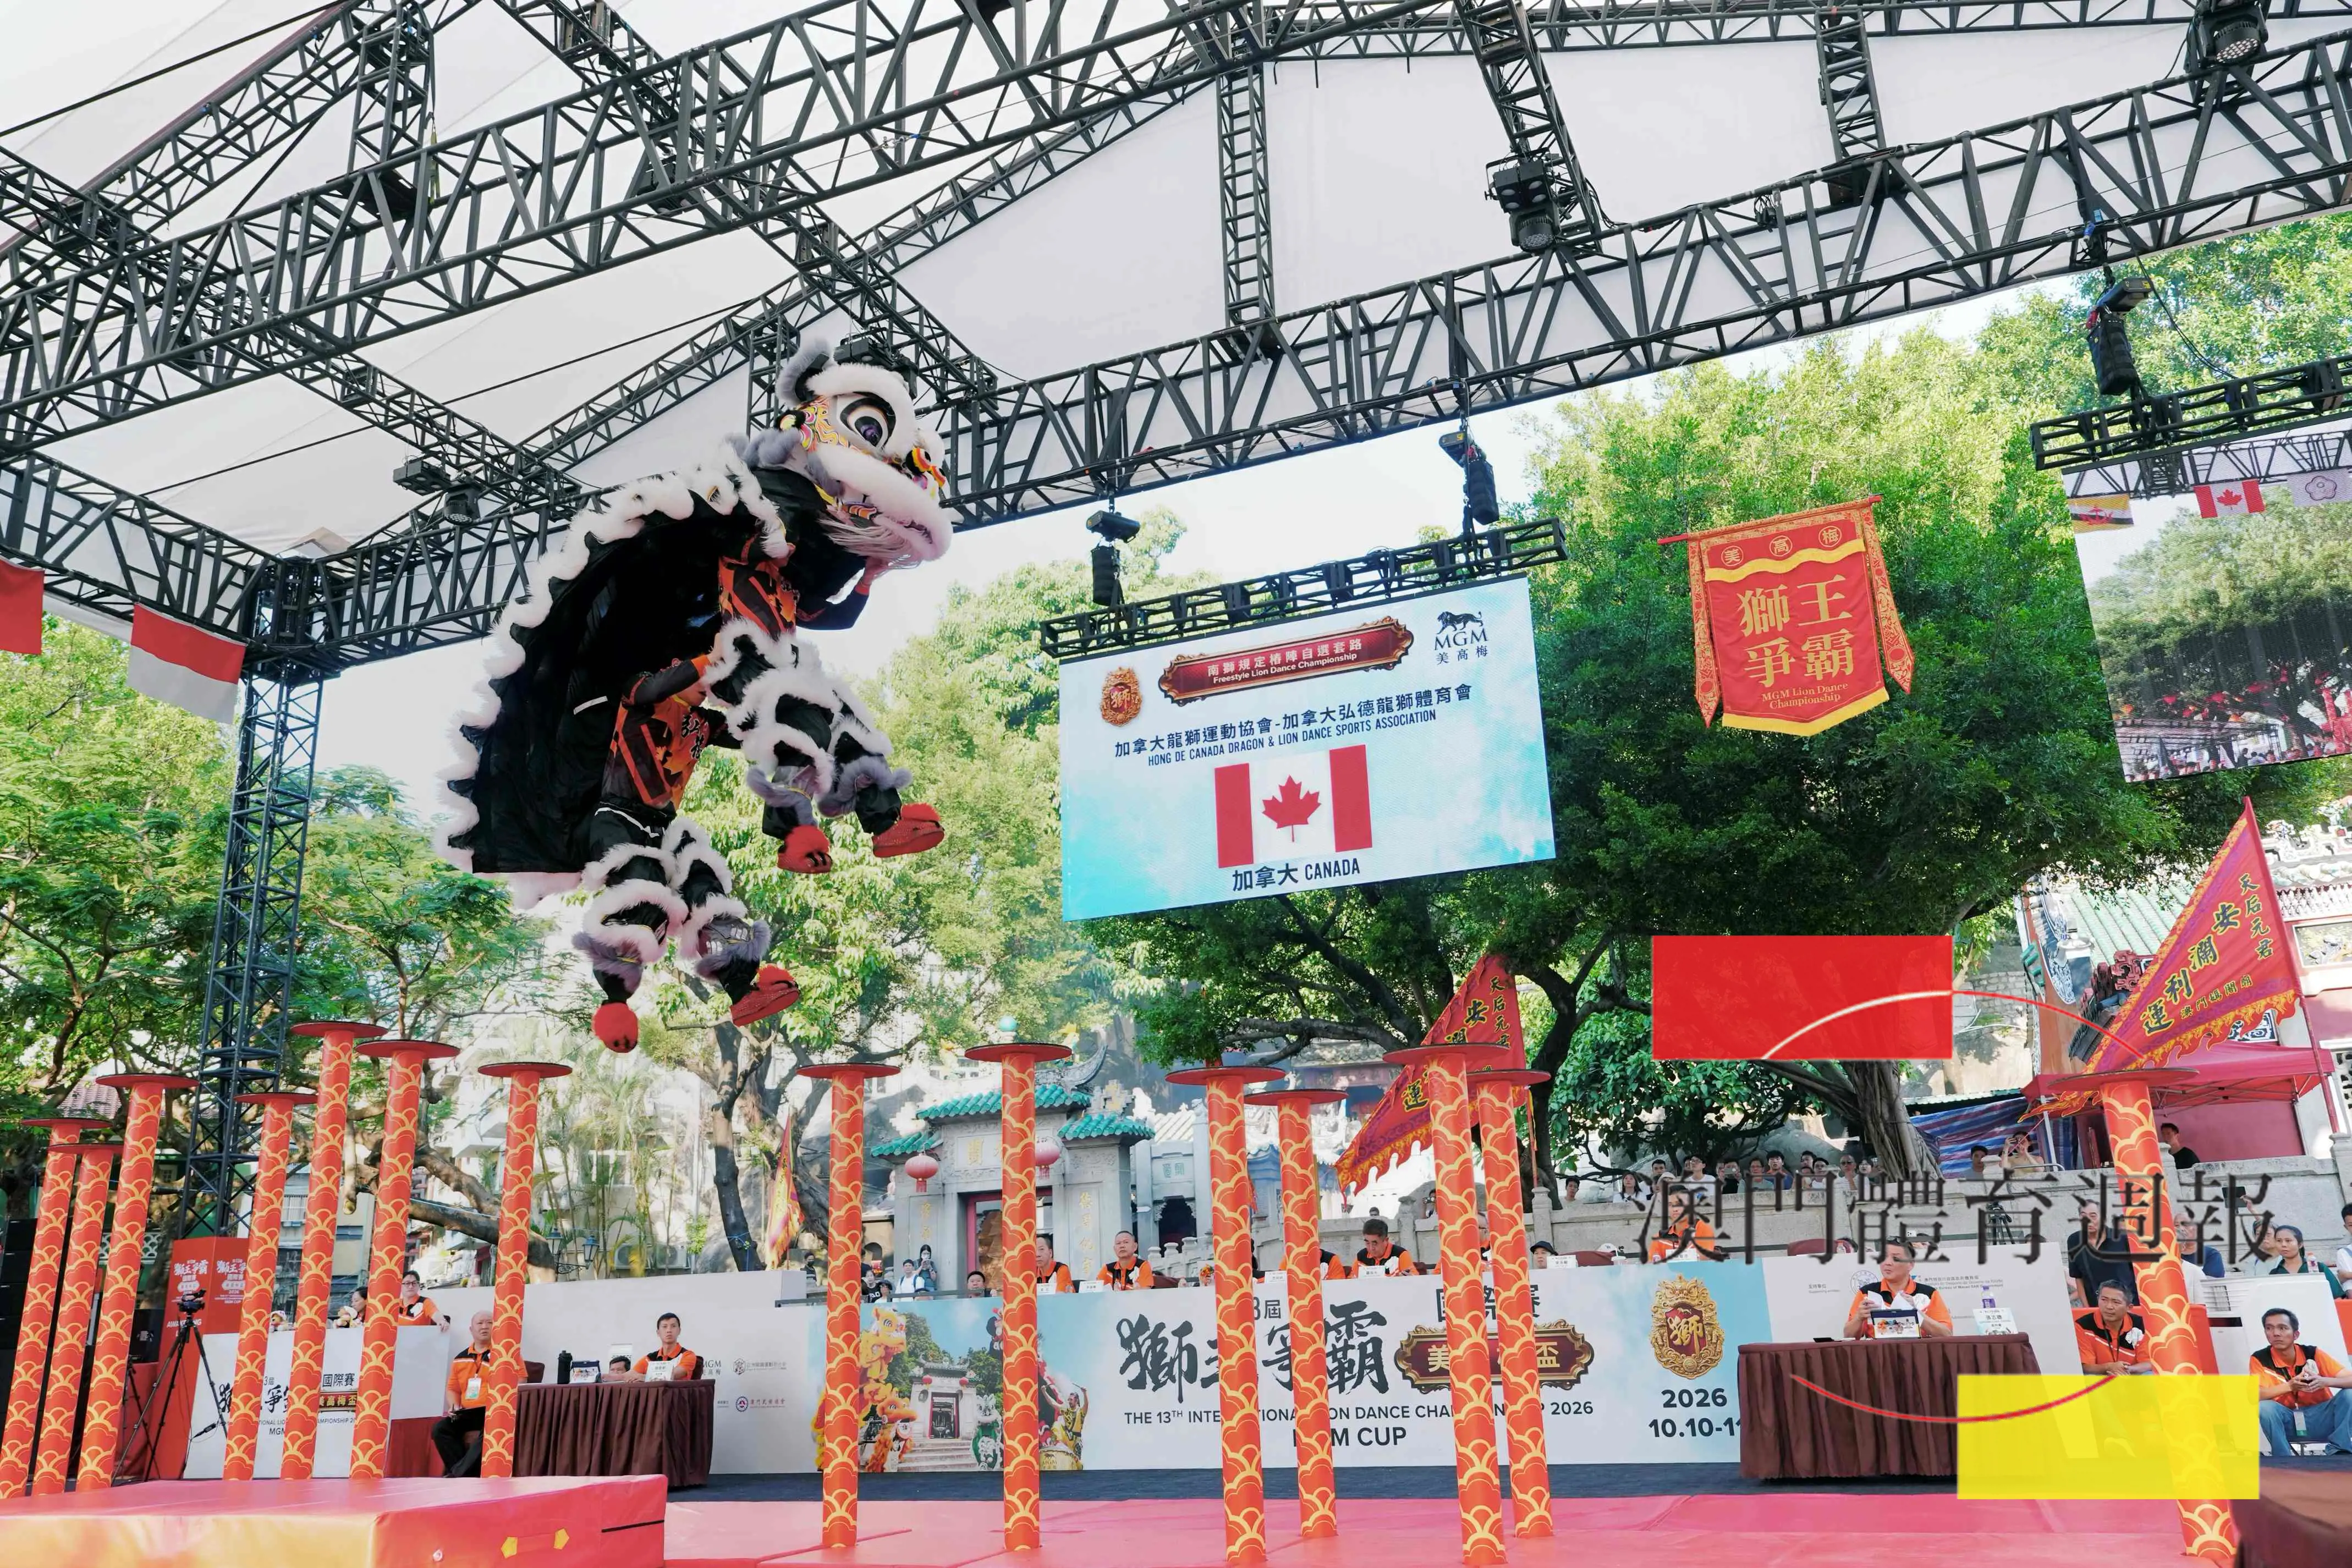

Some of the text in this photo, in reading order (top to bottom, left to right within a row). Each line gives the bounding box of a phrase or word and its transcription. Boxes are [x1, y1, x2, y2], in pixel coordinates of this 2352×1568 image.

[1724, 529, 1838, 561] 美高梅
[1737, 574, 1853, 637] 獅王
[1435, 628, 1488, 651] MGM
[1436, 645, 1488, 665] 美高梅
[1744, 629, 1854, 687] 爭霸
[1213, 653, 1357, 684] Freestyle Lion Dance Championship
[1762, 683, 1848, 702] MGM Lion Dance
[1770, 692, 1841, 709] Championship
[1148, 709, 1436, 766] HONG DE CANADA DRAGON & LION DANCE SPORTS ASSOCIATION
[1232, 857, 1361, 892] 加拿大 CANADA
[2239, 873, 2274, 960] 天后元君
[322, 1373, 355, 1387] 國際賽
[1661, 1388, 1728, 1408] 2026
[1125, 1412, 1152, 1424] THE
[1356, 1405, 1410, 1420] DANCE
[1551, 1401, 1593, 1415] 2026
[1358, 1426, 1406, 1446] CUP
